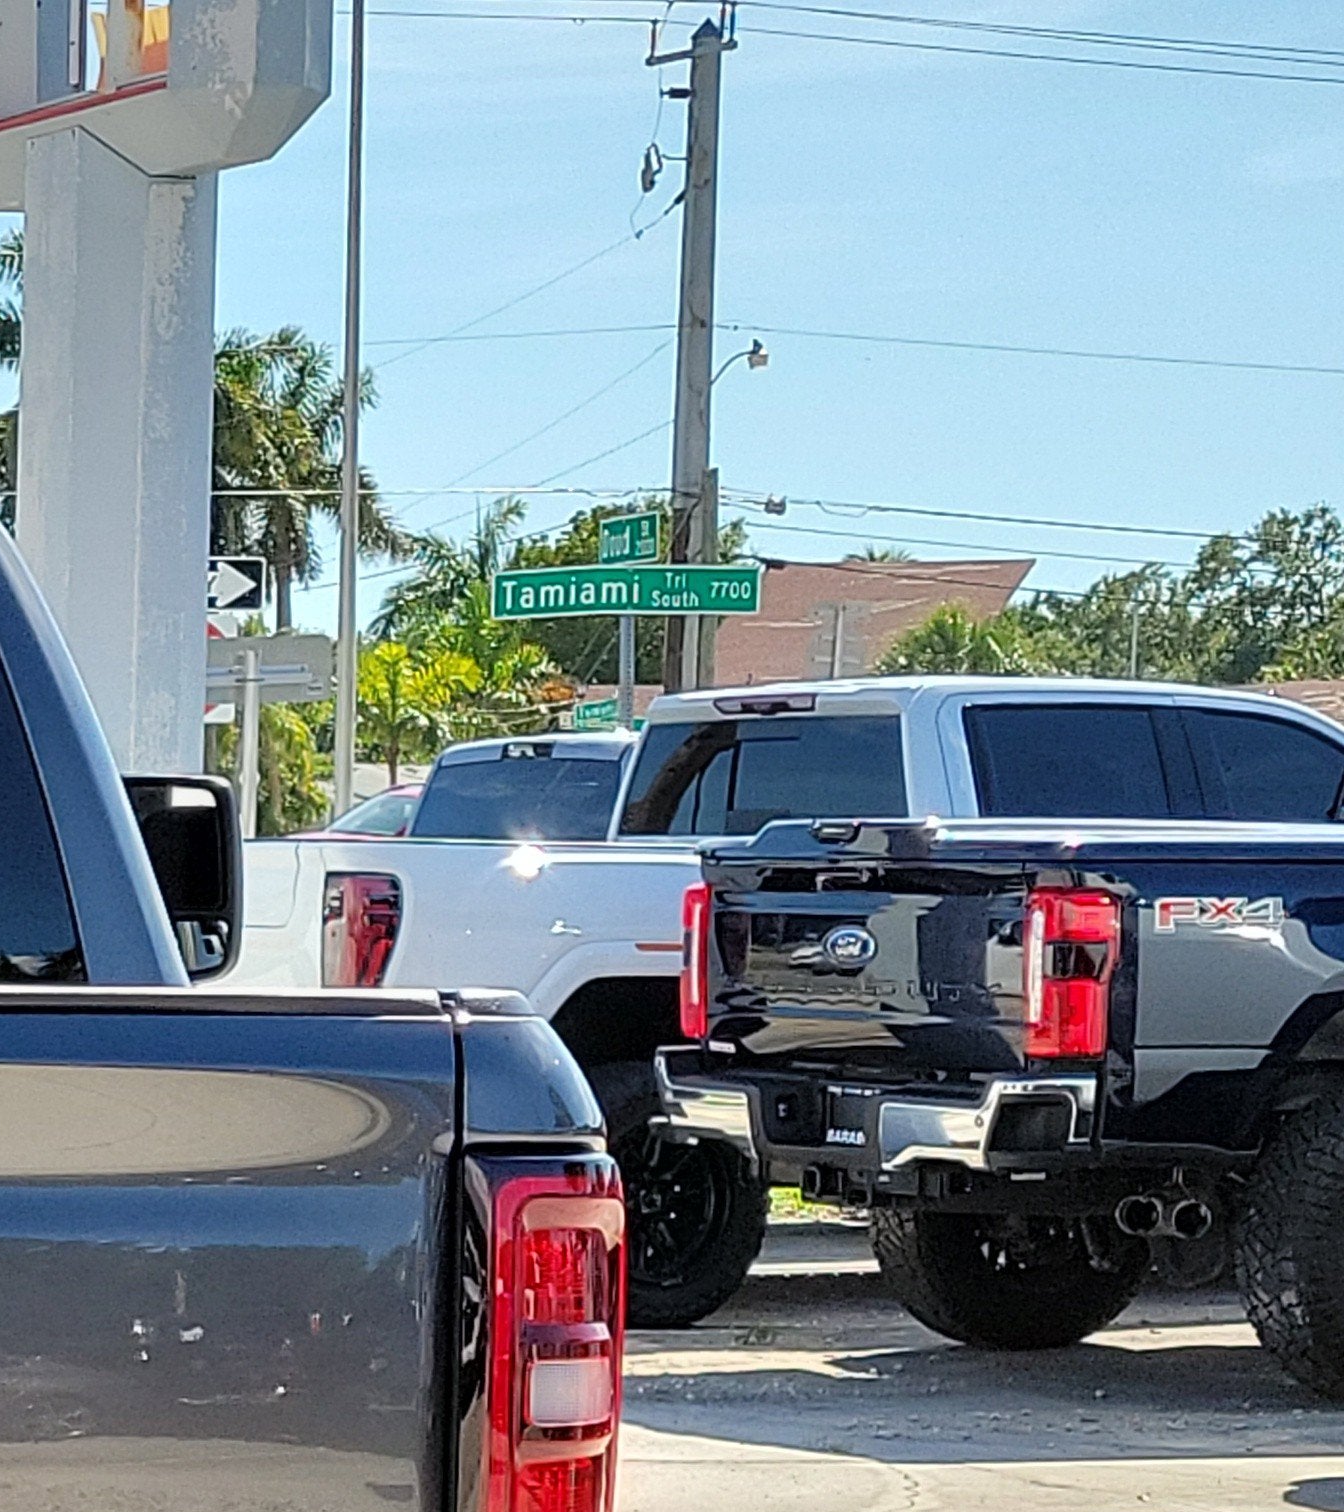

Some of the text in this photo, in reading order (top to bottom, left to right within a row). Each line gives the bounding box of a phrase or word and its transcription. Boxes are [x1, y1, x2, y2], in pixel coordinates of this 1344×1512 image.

[502, 572, 751, 610] Tamiami Trl 7700
[651, 590, 699, 607] South
[1154, 897, 1284, 934] FX4
